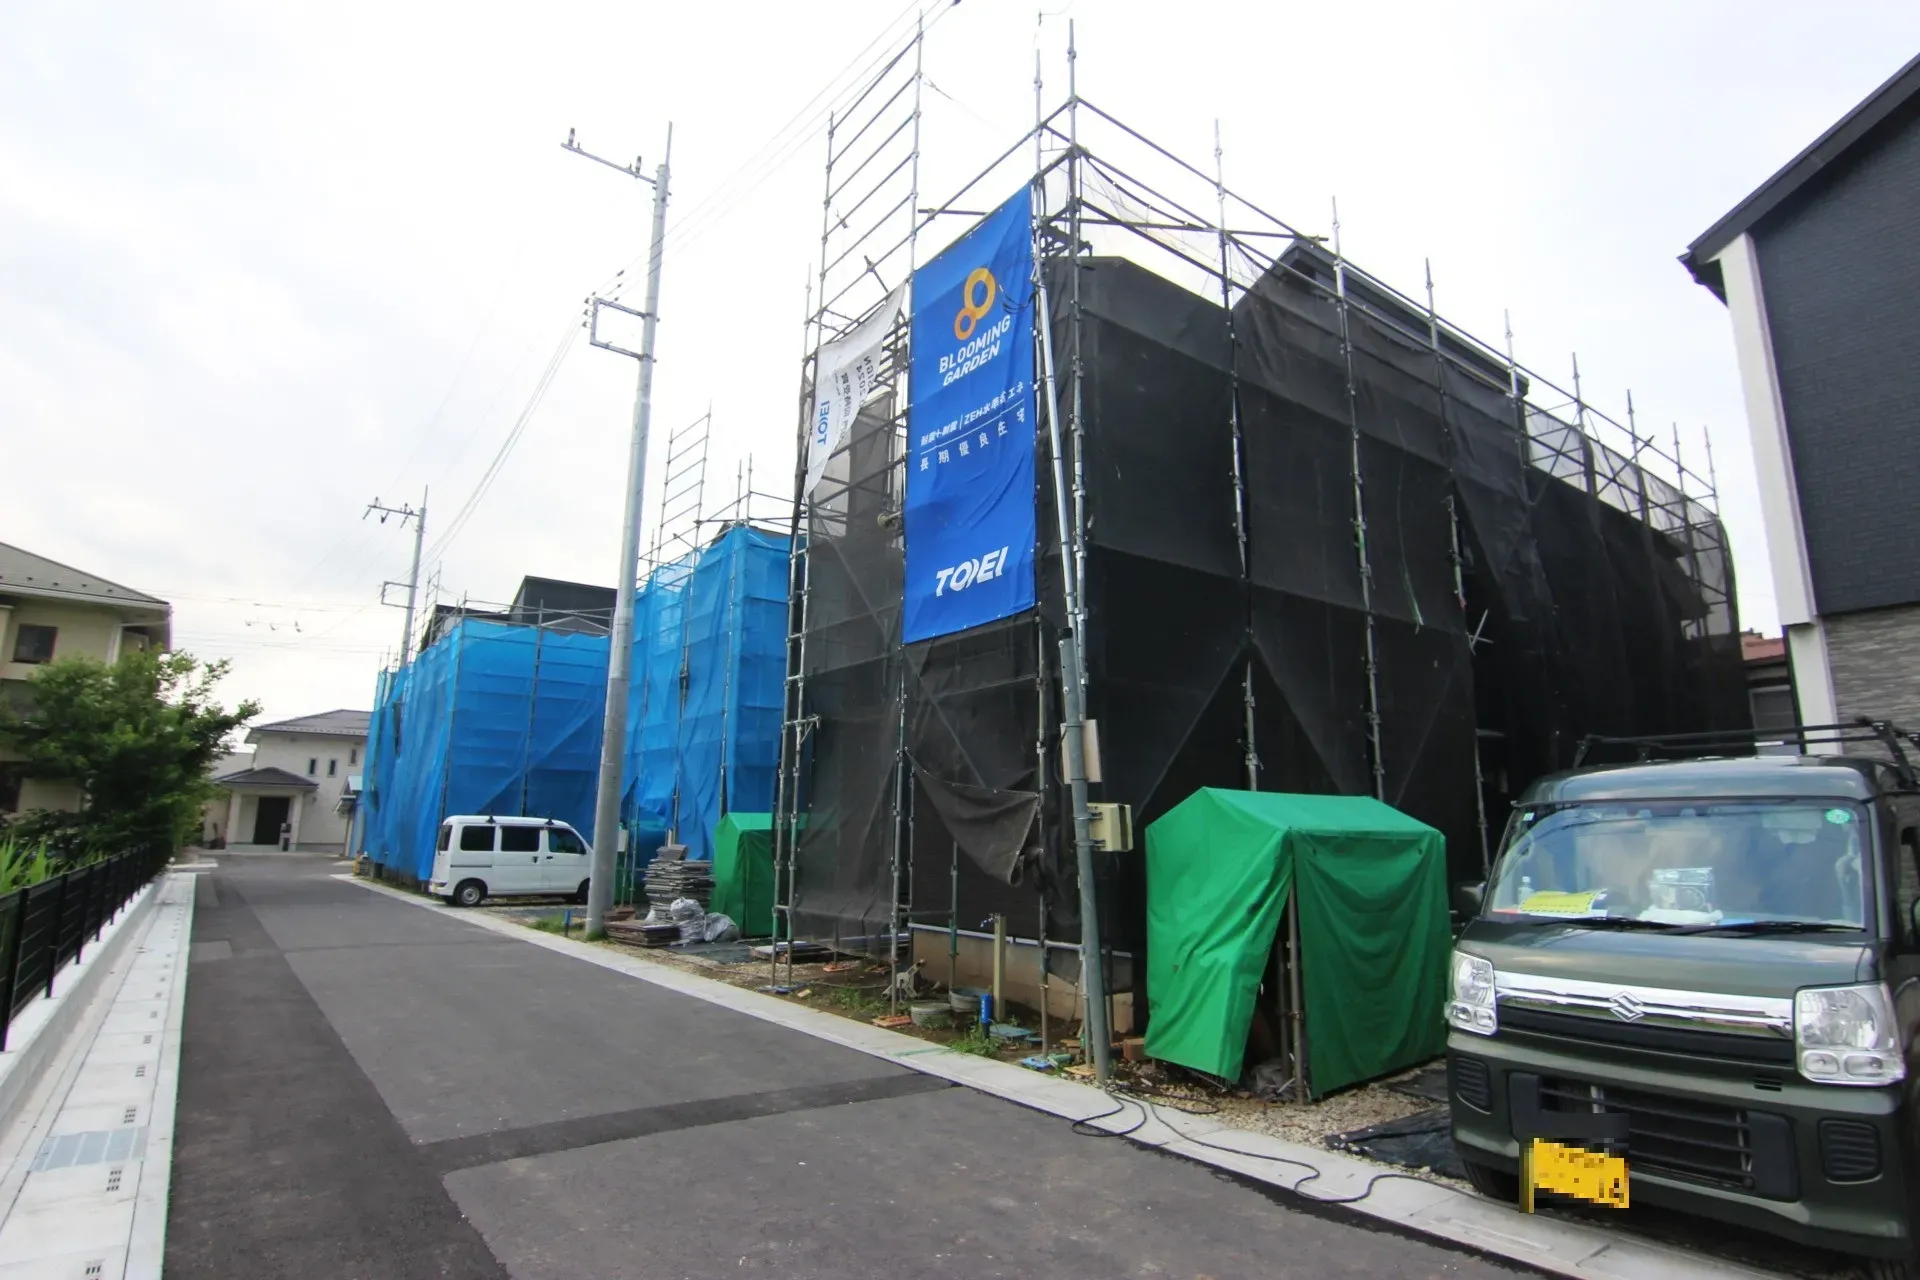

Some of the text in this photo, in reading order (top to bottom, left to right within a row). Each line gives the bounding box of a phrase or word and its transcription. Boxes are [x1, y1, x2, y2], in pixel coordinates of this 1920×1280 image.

[939, 314, 1011, 374] BLOOMING
[942, 340, 1001, 387] GARDEN
[920, 407, 1025, 472] 長期優良住宅
[935, 545, 1009, 597] TOEI
